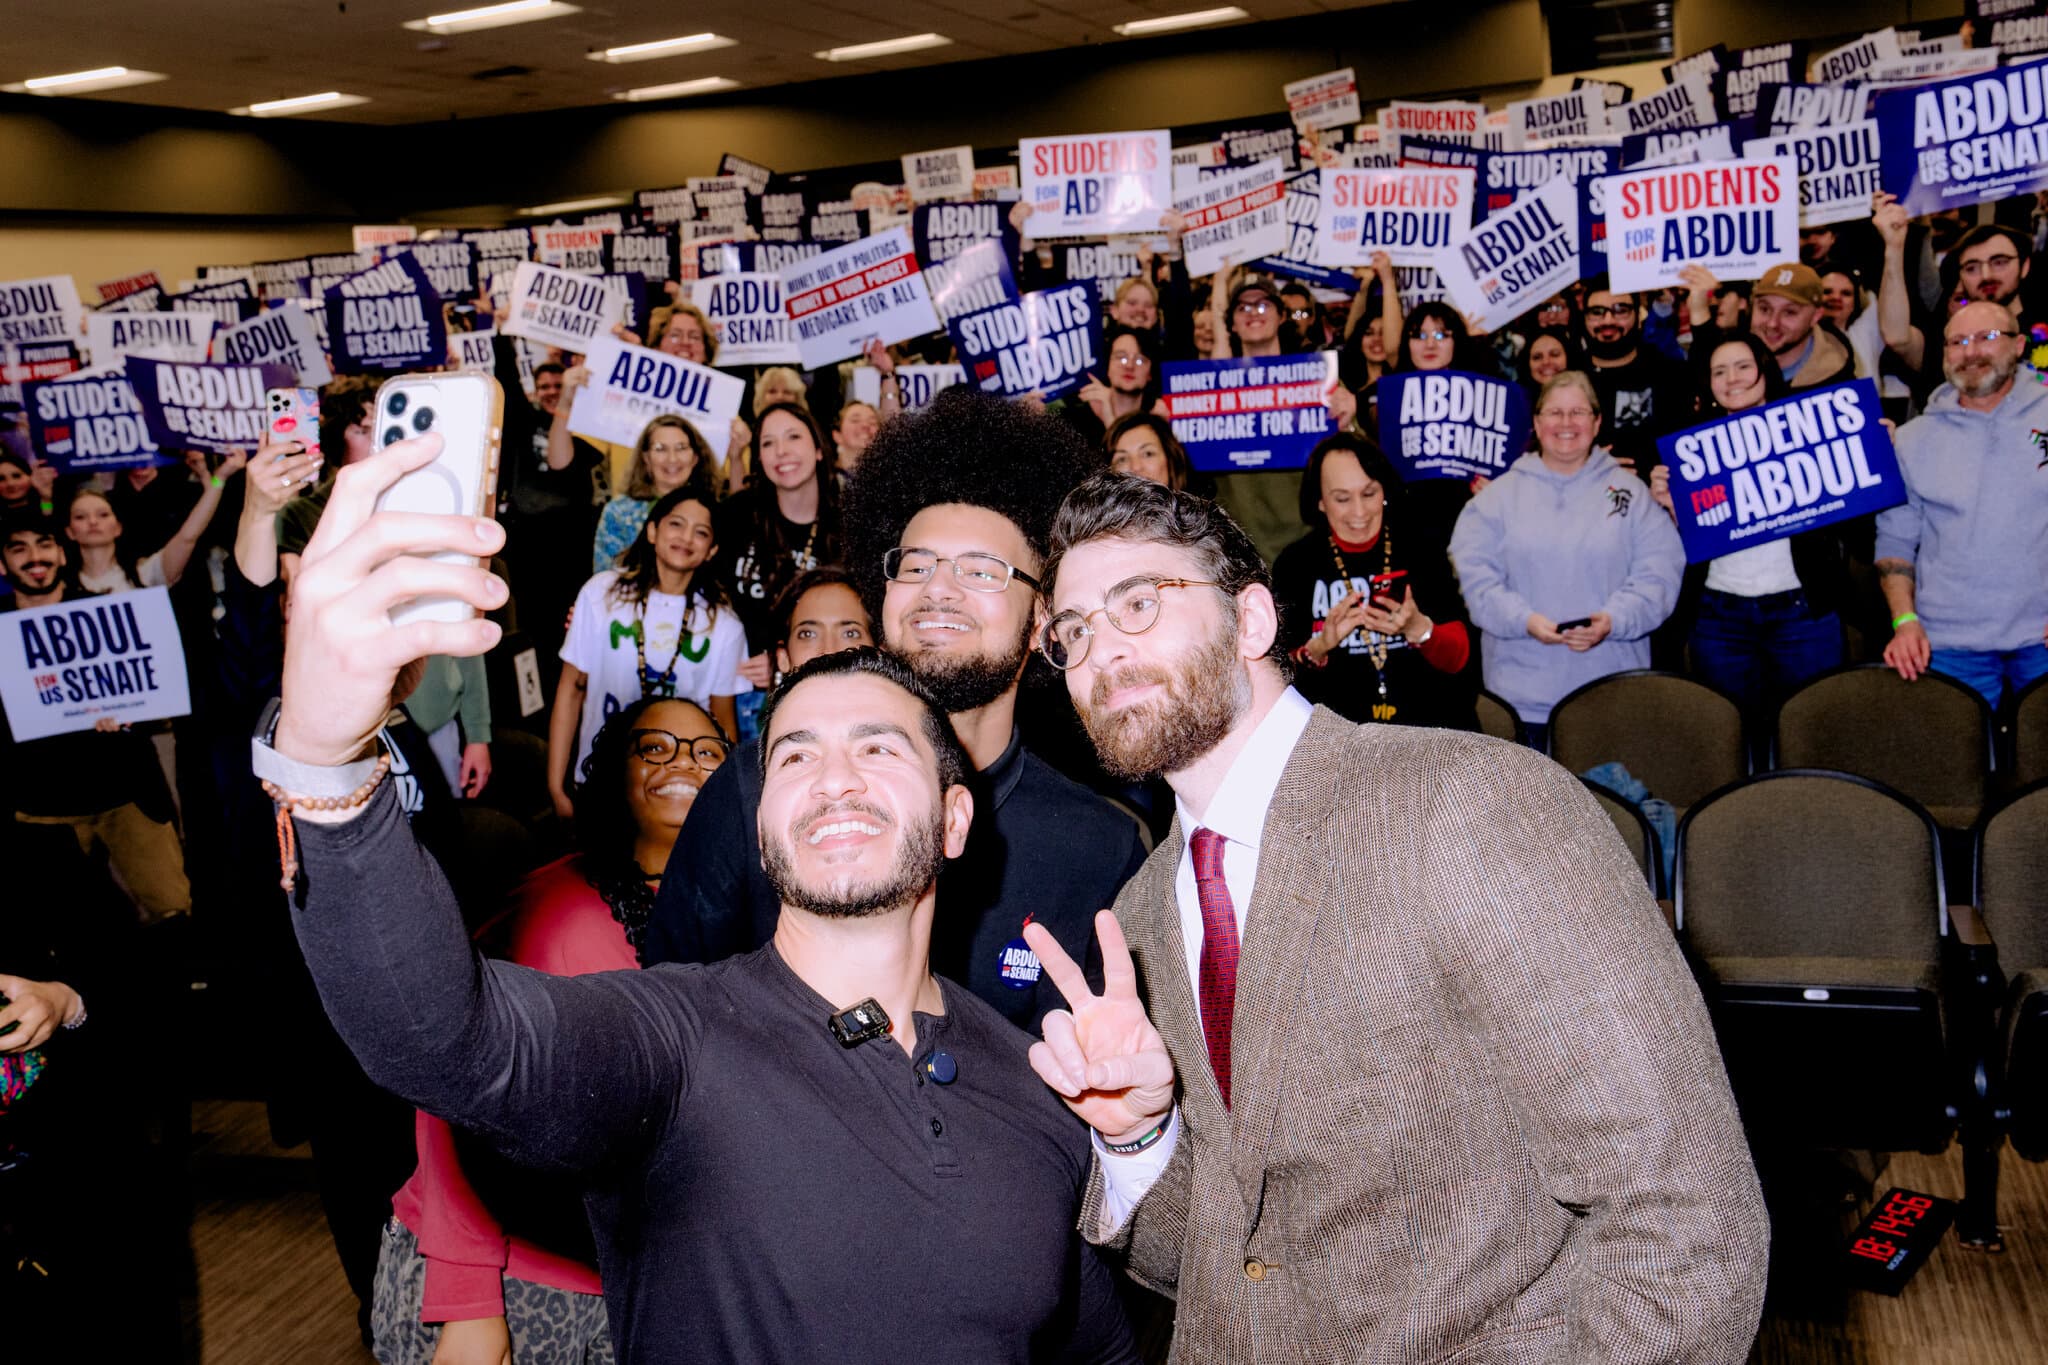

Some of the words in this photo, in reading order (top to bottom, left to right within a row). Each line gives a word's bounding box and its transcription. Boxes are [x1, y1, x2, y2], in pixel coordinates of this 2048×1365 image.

[1397, 107, 1476, 132] STUDENTS
[1525, 95, 1588, 130] ABDUL
[1628, 84, 1694, 132] ABDUL
[1034, 137, 1157, 177] STUDENTS
[1950, 122, 2048, 181] SENAT
[1035, 185, 1060, 203] FOR
[1333, 175, 1459, 208] STUDENTS
[1621, 164, 1780, 220] STUDENTS
[1799, 169, 1882, 207] SENATE
[546, 231, 601, 250] STUDEN
[927, 204, 1003, 239] ABDUL
[1185, 226, 1233, 252] EDICARE
[1238, 217, 1253, 234] FOR
[1461, 197, 1564, 281] ABDUL
[1624, 227, 1655, 250] FOR
[1661, 210, 1781, 263] ABDUL
[565, 250, 598, 269] ABD
[787, 275, 817, 294] MONEY
[816, 263, 835, 281] OUT
[838, 259, 851, 275] OF
[852, 238, 901, 269] POLITICS
[1500, 231, 1578, 295] SENATE
[0, 283, 61, 318] BDUL
[343, 294, 430, 334] ABDUL
[527, 271, 606, 318] ABDUL
[709, 279, 781, 317] ABDU
[797, 299, 858, 340] MEDICARE
[861, 288, 890, 318] FOR
[892, 280, 918, 307] ALL
[1, 316, 67, 342] SENATE
[112, 318, 198, 349] ABDUL
[224, 314, 299, 366] ABDUL
[958, 285, 1091, 356] STUDENTS
[364, 328, 433, 357] SENATE
[997, 326, 1097, 394] ABDUL
[609, 350, 713, 414] ABDUL
[1170, 371, 1216, 394] MONEY
[1218, 368, 1245, 389] OUT
[1248, 366, 1265, 386] OF
[1267, 361, 1327, 384] POLITICS
[35, 380, 141, 421] STUDEN
[1171, 393, 1217, 415] MONEY
[1220, 391, 1236, 411] IN
[1238, 388, 1275, 410] YOUR
[1400, 375, 1510, 434] ABDUL
[187, 409, 266, 443] SENAT
[1171, 412, 1256, 443] MEDICARE
[1261, 410, 1294, 437] FOR
[1298, 406, 1328, 433] ALL
[1675, 387, 1866, 482] STUDENTS
[1423, 422, 1508, 468] SENATE
[1690, 484, 1728, 514] FOR
[1731, 434, 1882, 525] ABDUL
[19, 602, 152, 670] ABDUL
[39, 685, 64, 706] US
[62, 655, 159, 703] SENATE
[1372, 704, 1397, 720] VIP
[1003, 947, 1042, 969] ABDUL
[1010, 966, 1040, 981] SENATE
[1850, 1192, 1933, 1262] 18:14:56
